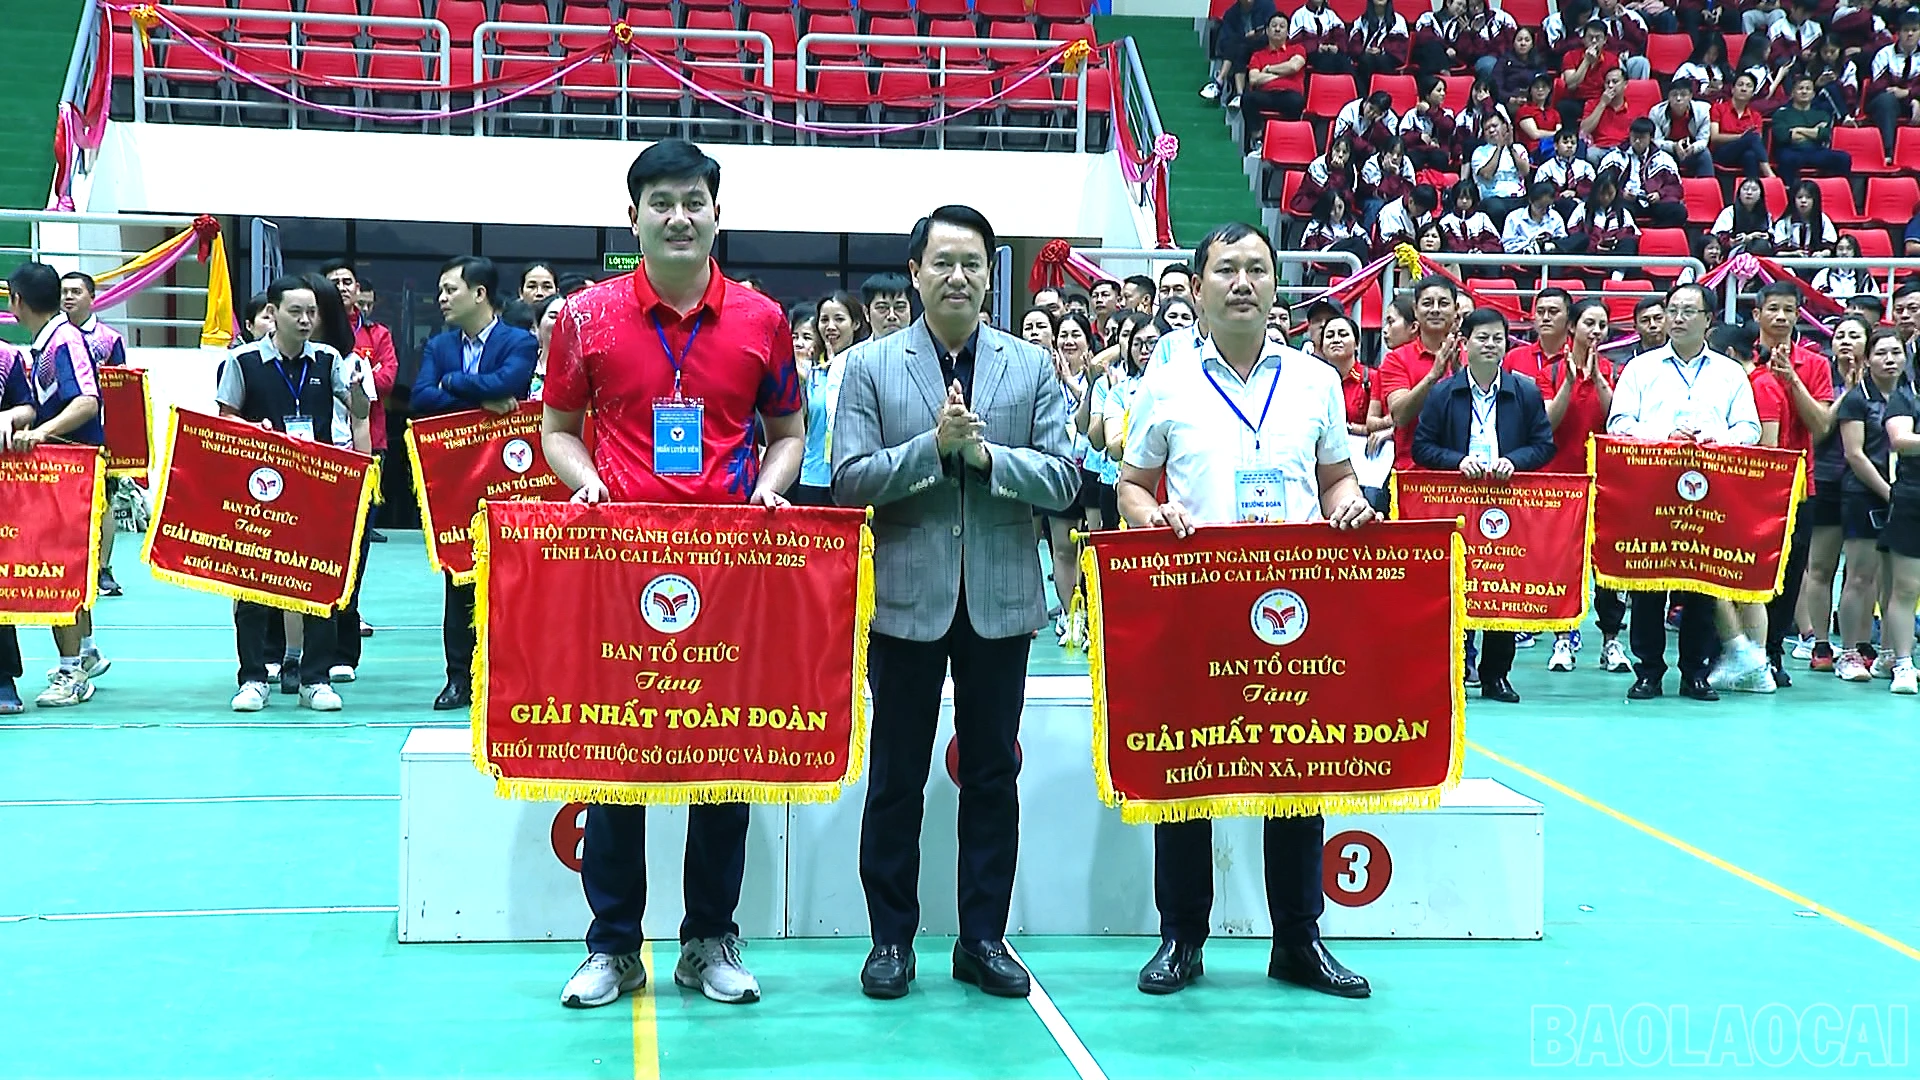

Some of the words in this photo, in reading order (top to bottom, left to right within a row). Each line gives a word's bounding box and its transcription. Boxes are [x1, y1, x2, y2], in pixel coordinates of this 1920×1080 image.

[16, 473, 37, 482] NĂM
[40, 474, 59, 483] 2025
[25, 461, 38, 471] VÀ
[63, 464, 84, 474] TẠO
[486, 480, 511, 495] BAN
[223, 500, 243, 515] BAN
[263, 510, 298, 525] CHỨC
[1655, 506, 1676, 516] BAN
[1678, 504, 1694, 516] TỔ
[0, 526, 19, 538] ỨC
[439, 525, 465, 544] GIẢI
[501, 527, 528, 542] ĐẠI
[534, 524, 563, 542] HỘI
[567, 527, 608, 539] TDTT
[612, 527, 668, 543] NGÀNH
[672, 529, 712, 544] GIÁO
[716, 532, 748, 548] DỤC
[752, 530, 772, 545] VÀ
[776, 531, 810, 547] ĐÀO
[813, 536, 844, 552] TẠO
[162, 522, 189, 541] GIẢI
[190, 530, 234, 551] KHUYẾN
[235, 541, 272, 561] KHÍCH
[274, 550, 309, 569] TOÀN
[310, 560, 342, 578] ĐOÀN
[541, 544, 581, 560] TỈNH
[584, 544, 616, 560] LÀO
[620, 550, 648, 562] CAI
[652, 545, 684, 564] LẦN
[688, 549, 721, 564] THỨ
[724, 553, 733, 567] I,
[738, 550, 771, 565] NĂM
[775, 554, 806, 567] 2025
[1110, 558, 1137, 572] ĐẠI
[1141, 552, 1170, 570] HỘI
[1173, 552, 1212, 566] TDTT
[1216, 548, 1270, 563] NGÀNH
[1274, 545, 1312, 562] GIÁO
[1316, 549, 1349, 563] DỤC
[1352, 545, 1372, 560] VÀ
[1376, 546, 1408, 560] ĐÀO
[1413, 549, 1444, 563] TẠO
[1465, 545, 1476, 554] AN
[1478, 542, 1492, 555] TỔ
[1495, 544, 1526, 557] CHỨC
[1615, 538, 1647, 553] GIẢI
[1650, 541, 1667, 552] BA
[1671, 540, 1710, 556] TOÀN
[1713, 548, 1756, 564] ĐOÀN
[14, 562, 65, 578] ĐOÀN
[183, 553, 212, 569] KHỐI
[215, 562, 238, 577] LIÊN
[261, 572, 312, 592] PHƯỜNG
[1625, 556, 1652, 569] KHỐI
[1150, 570, 1187, 587] TỈNH
[1191, 568, 1220, 584] LÀO
[1225, 570, 1251, 582] CAI
[1255, 564, 1286, 581] LẦN
[1289, 565, 1321, 580] THỨ
[1325, 568, 1334, 581] I,
[1338, 565, 1372, 579] NĂM
[1376, 567, 1405, 579] 2025
[1465, 578, 1478, 592] HÌ
[1482, 579, 1521, 593] TOÀN
[1525, 582, 1566, 596] ĐOÀN
[21, 587, 33, 599] VÀ
[60, 589, 80, 601] TẠO
[1467, 600, 1481, 609] ÊN
[1502, 601, 1548, 613] PHƯỜNG
[602, 642, 642, 661] BAN
[648, 639, 677, 662] TỔ
[683, 642, 739, 662] CHỨC
[1209, 660, 1249, 677] BAN
[1254, 652, 1282, 675] TỔ
[1288, 655, 1346, 675] CHỨC
[635, 671, 702, 694] Tặng
[1243, 684, 1309, 705] Tặng
[511, 697, 572, 724] GIẢI
[580, 699, 658, 728] NHẤT
[665, 703, 741, 729] TOÀN
[748, 705, 827, 730] ĐOÀN
[1127, 724, 1184, 751] GIẢI
[1191, 715, 1263, 748] NHẤT
[1270, 718, 1346, 744] TOÀN
[1354, 718, 1429, 743] ĐOÀN
[492, 738, 532, 758] KHỐI
[537, 742, 580, 762] TRỰC
[584, 743, 638, 764] THUỘC
[641, 745, 662, 764] SỞ
[666, 745, 704, 764] GIÁO
[708, 748, 739, 766] DỤC
[744, 745, 763, 764] VÀ
[768, 747, 800, 766] ĐÀO
[804, 751, 835, 768] TẠO
[1166, 757, 1212, 784] KHỐI
[1218, 756, 1263, 777] LIÊN
[1269, 758, 1302, 779] XÃ,
[1307, 756, 1391, 777] PHƯỜNG
[1337, 843, 1371, 892] 3
